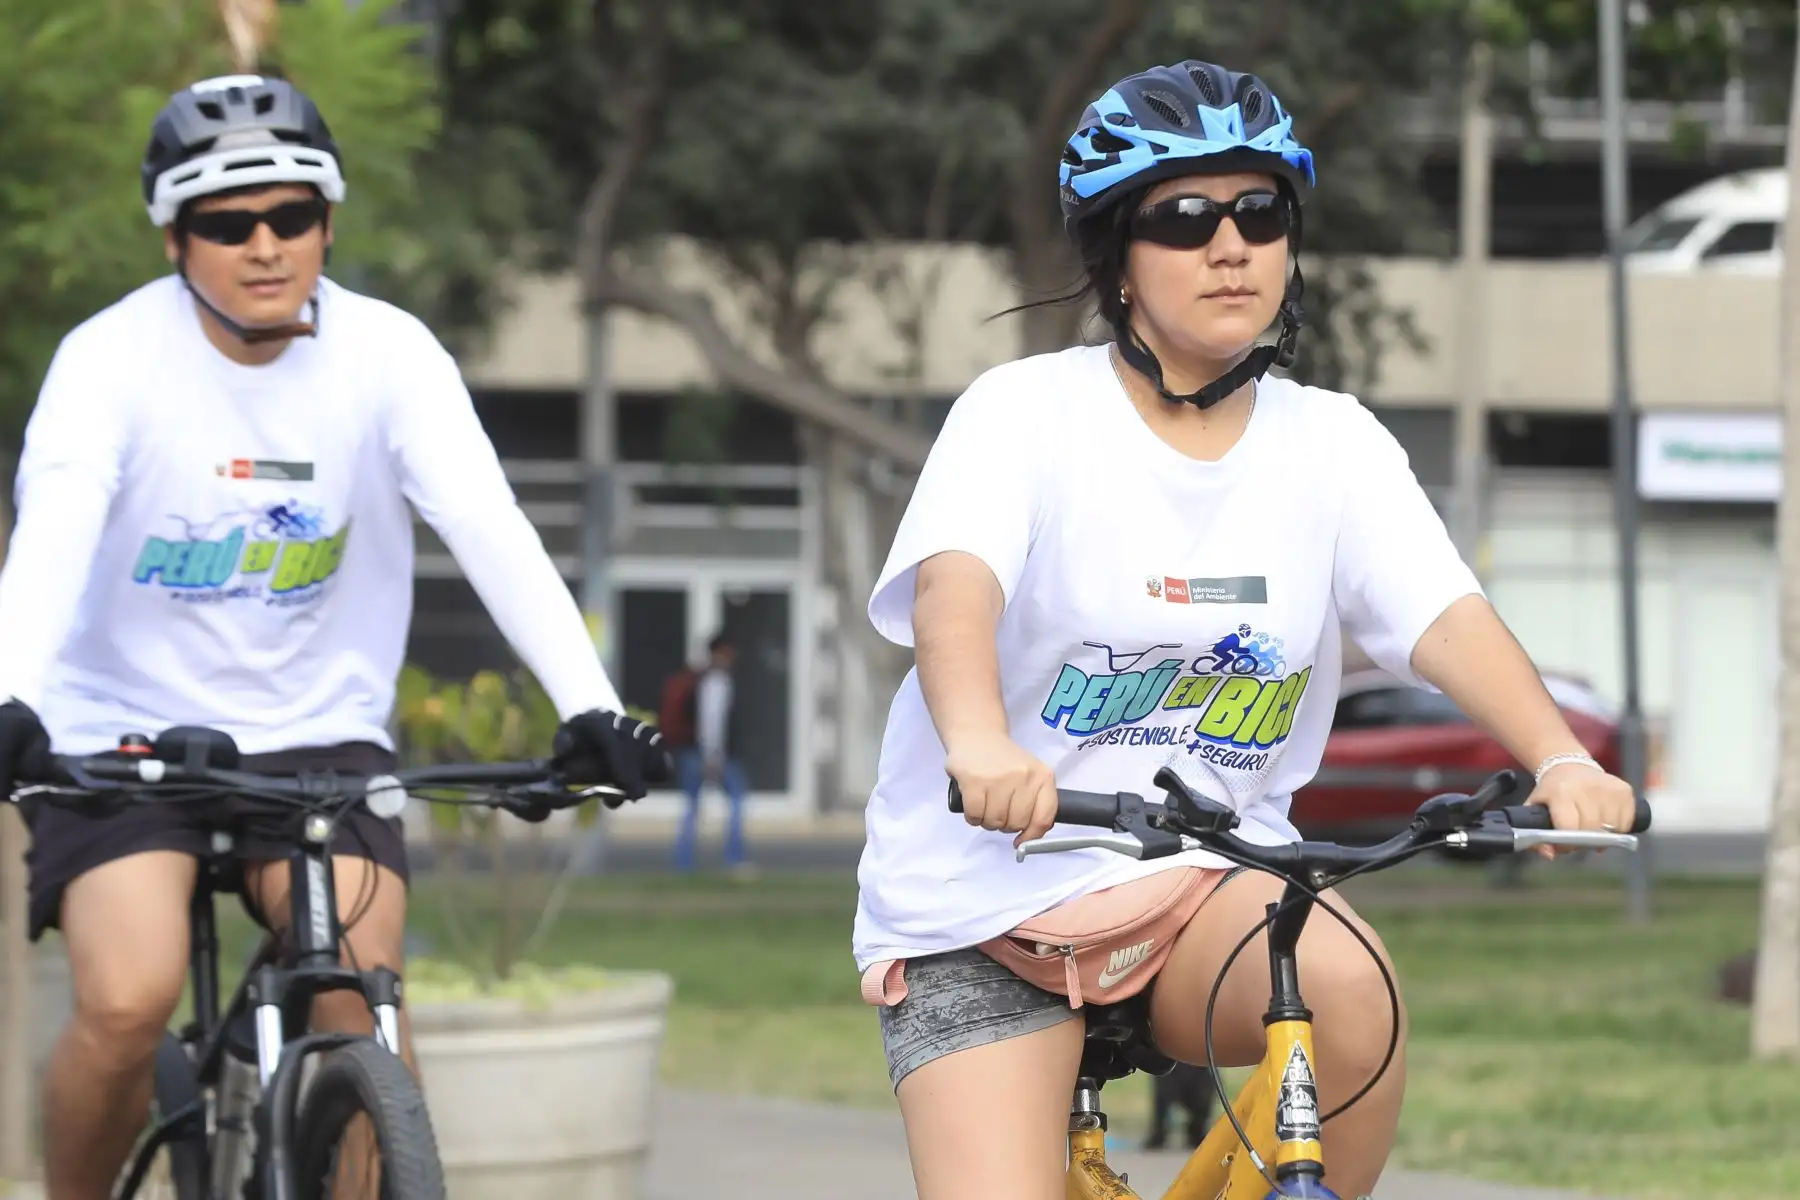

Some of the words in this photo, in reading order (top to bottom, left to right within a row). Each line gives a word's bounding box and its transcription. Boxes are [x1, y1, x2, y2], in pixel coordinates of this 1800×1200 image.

[1166, 585, 1186, 596] PERÚ
[1192, 586, 1226, 594] Ministerio
[1205, 593, 1237, 601] Ambiente
[1040, 659, 1185, 737] PERÚ
[1162, 676, 1222, 711] EN
[1194, 665, 1312, 750] BICI
[1186, 738, 1269, 771] +SEGURO
[1107, 938, 1155, 972] NIKE
